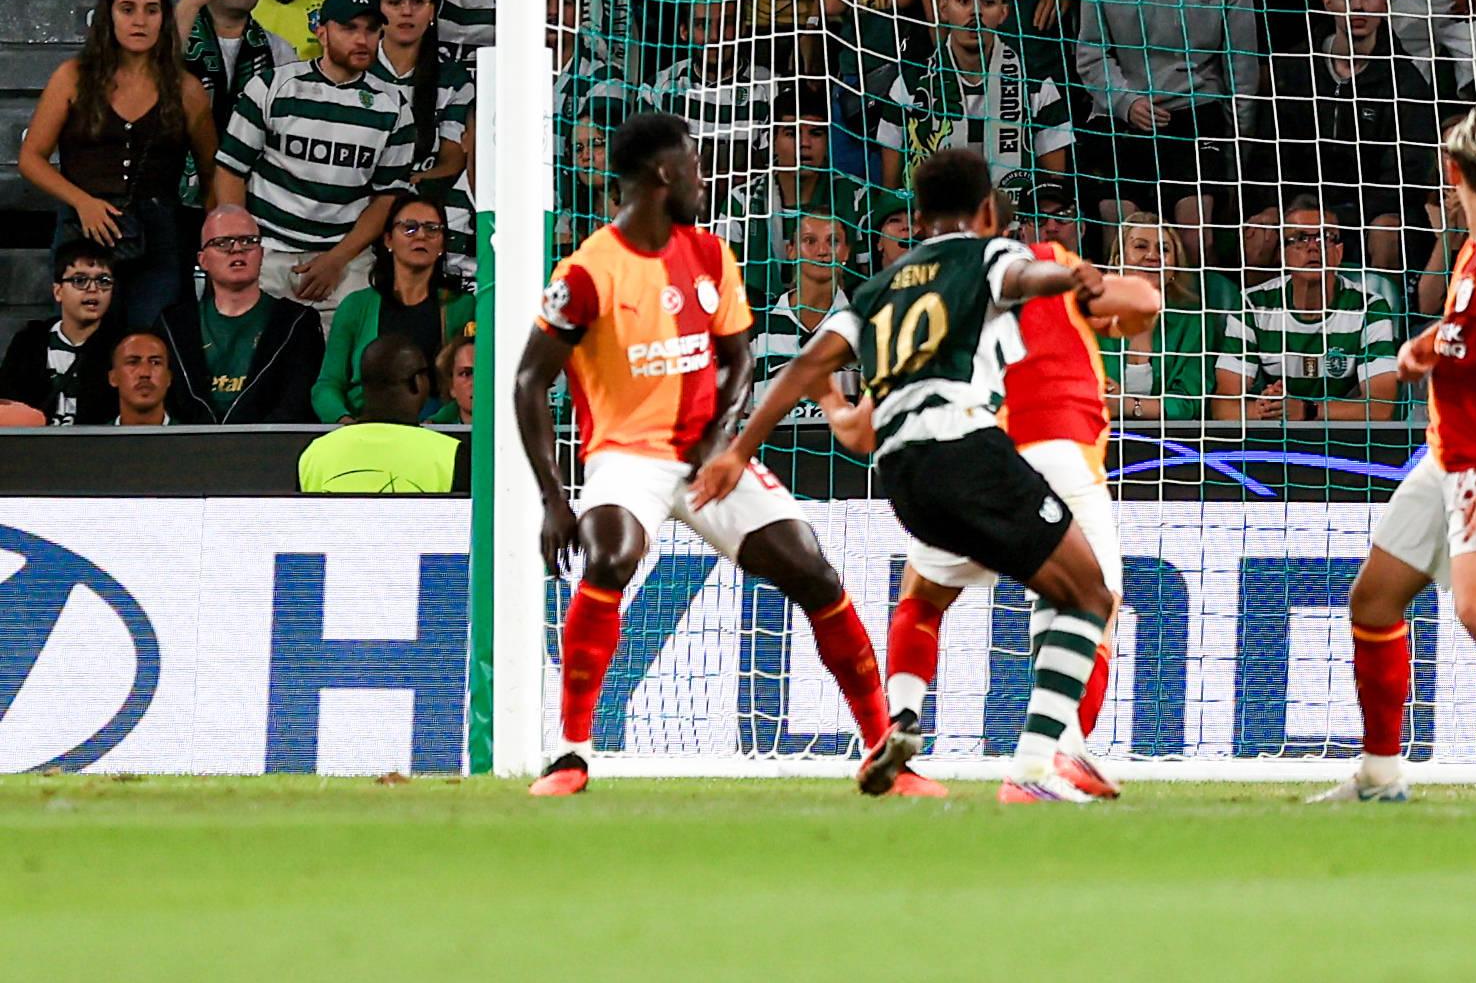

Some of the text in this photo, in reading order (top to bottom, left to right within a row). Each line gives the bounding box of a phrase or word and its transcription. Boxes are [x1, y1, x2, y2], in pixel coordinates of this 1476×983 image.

[999, 63, 1021, 122] QUERO
[999, 128, 1018, 154] EU
[870, 292, 950, 394] 10
